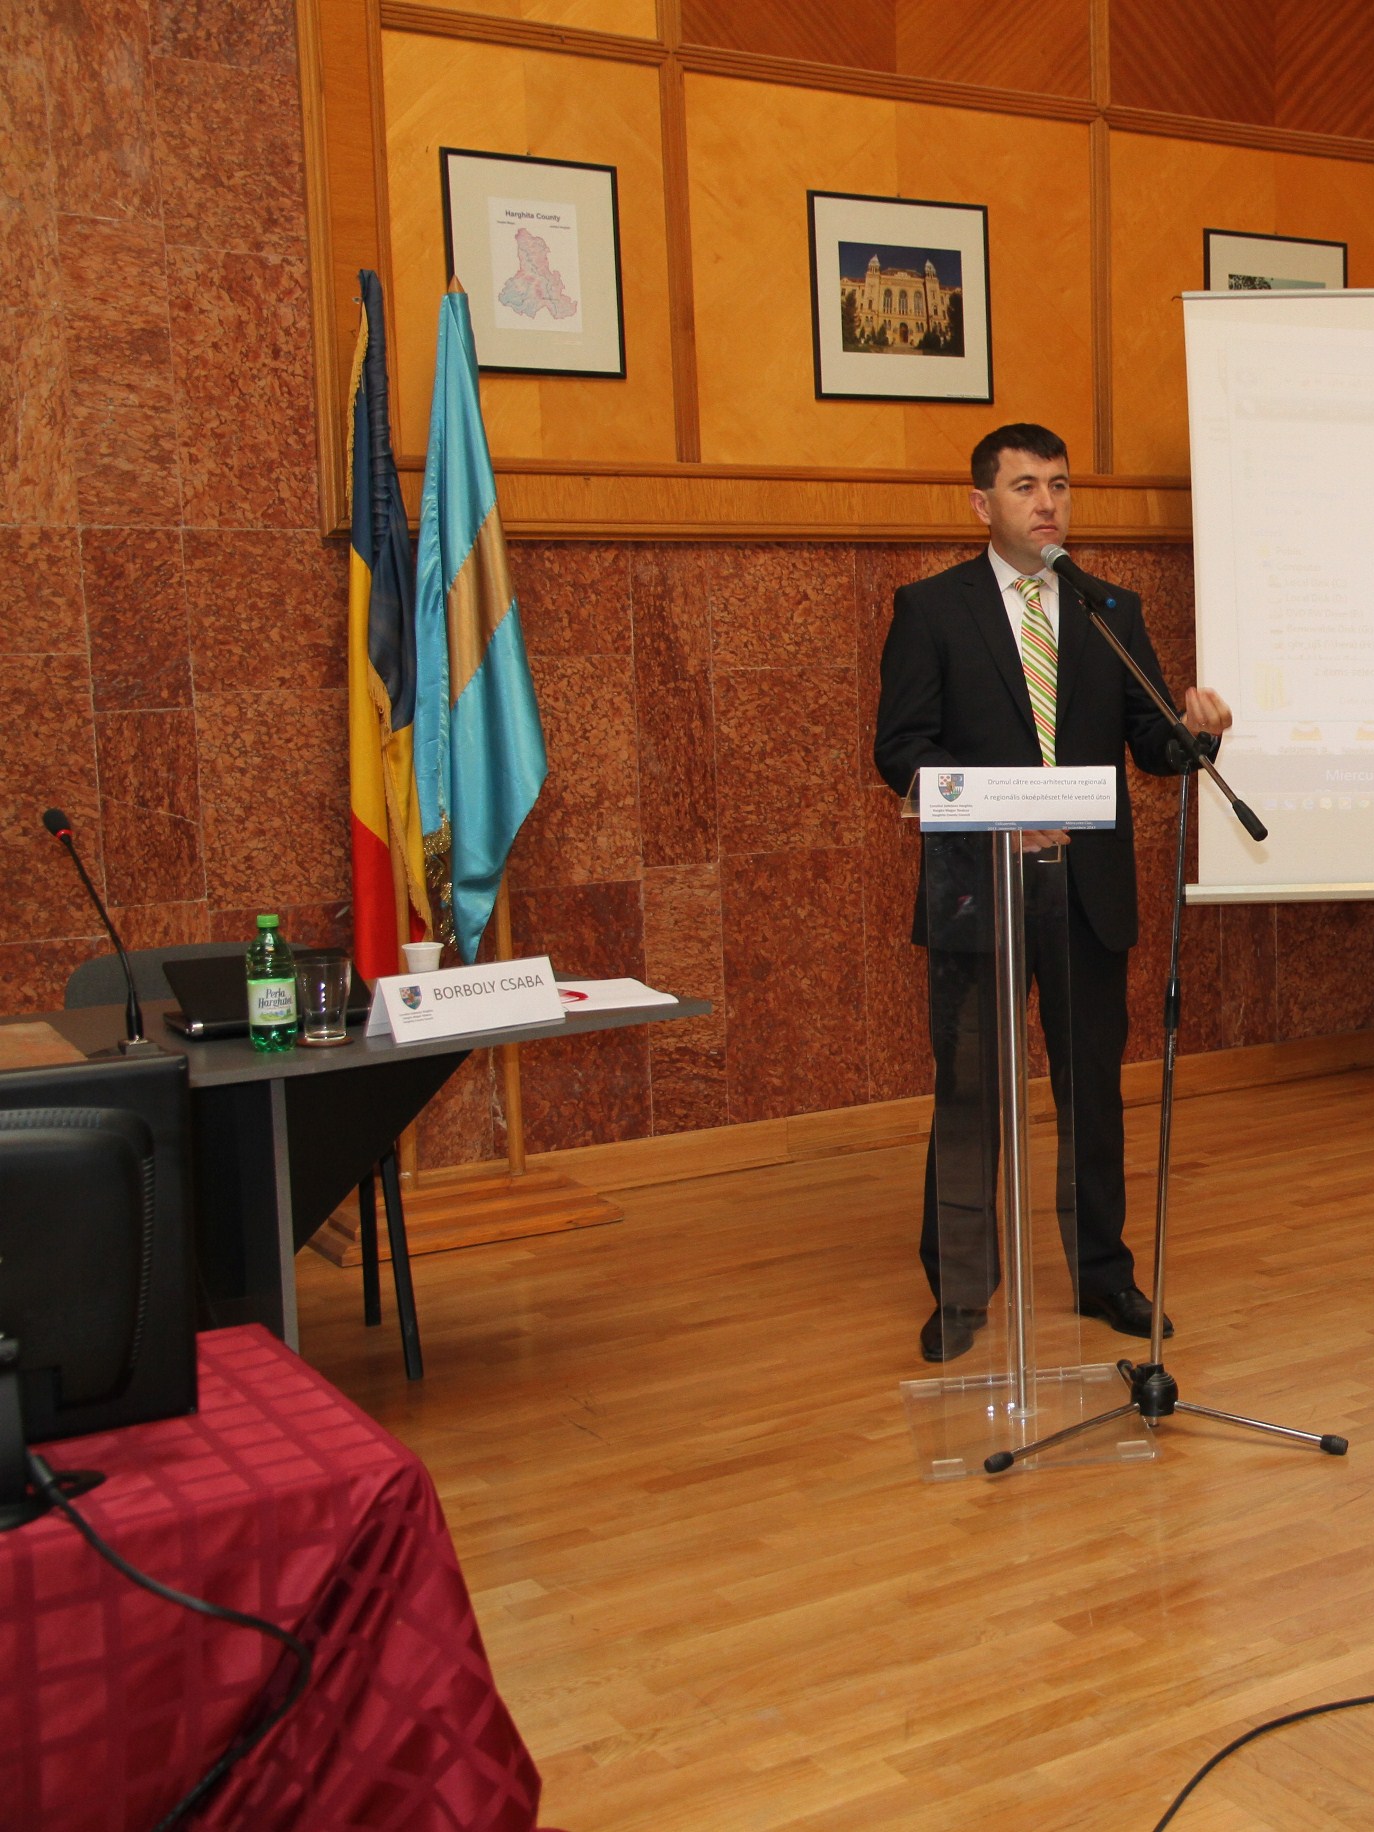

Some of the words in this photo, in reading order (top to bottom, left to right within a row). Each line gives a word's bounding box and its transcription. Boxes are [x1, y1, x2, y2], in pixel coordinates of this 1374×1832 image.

[505, 210, 535, 219] Harghita
[536, 213, 561, 222] County
[987, 778, 1011, 786] Drumul
[1029, 778, 1077, 786] eco-arhitectura
[990, 793, 1020, 803] regionális
[1096, 793, 1111, 801] úton
[266, 987, 286, 999] Perla
[433, 981, 496, 1001] BORBOLY
[500, 974, 545, 992] CSABA
